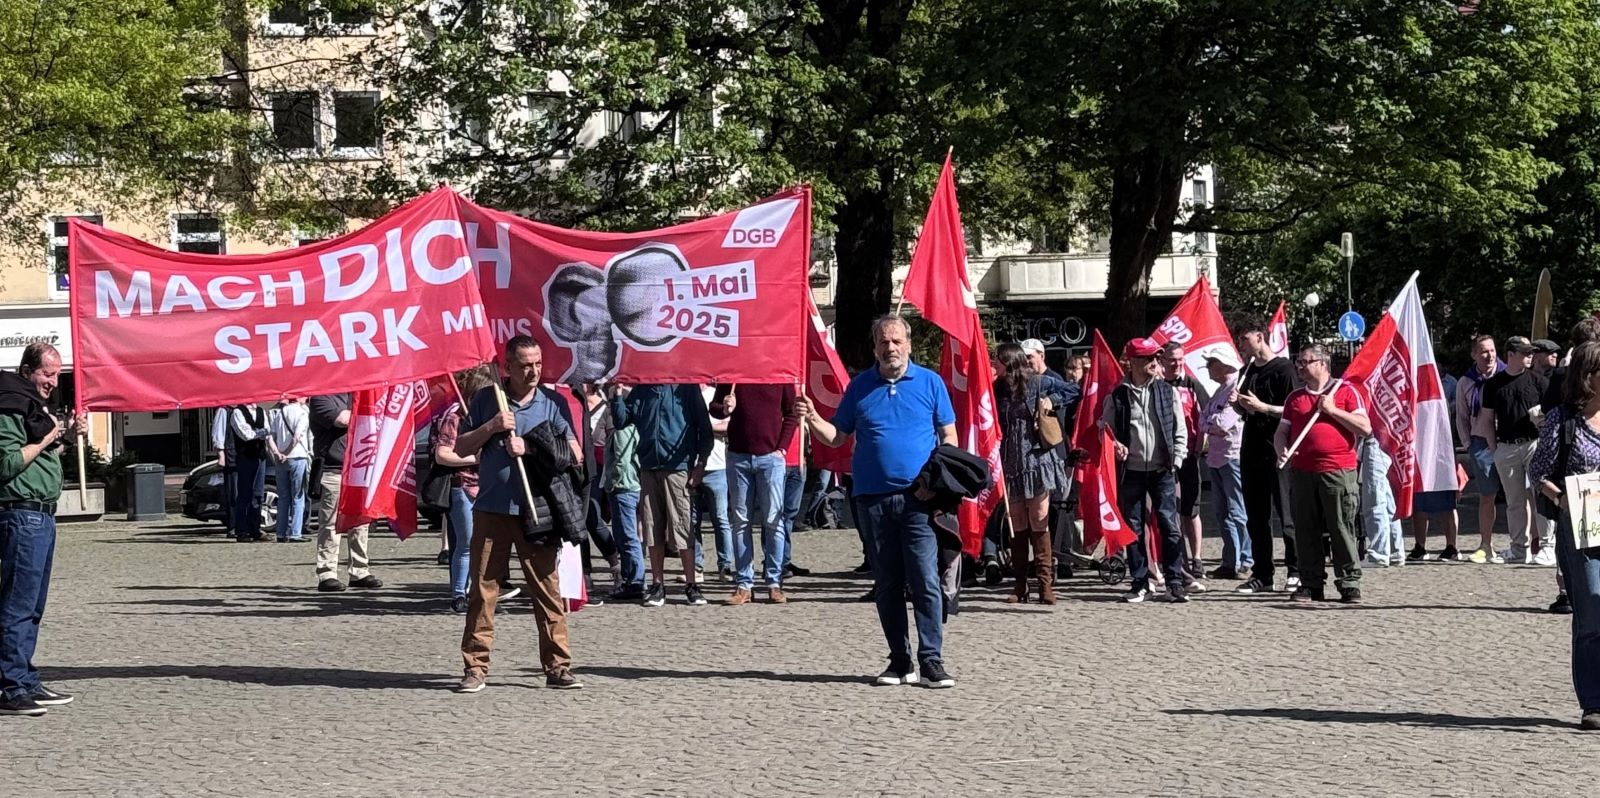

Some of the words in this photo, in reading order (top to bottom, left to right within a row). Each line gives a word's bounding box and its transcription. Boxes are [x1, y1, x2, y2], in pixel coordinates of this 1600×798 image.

[733, 229, 774, 245] DGB
[94, 270, 305, 319] MACH
[318, 219, 512, 303] DICH
[664, 279, 684, 301] 1.
[691, 269, 747, 299] Mai
[656, 305, 731, 337] 2025
[1160, 315, 1193, 344] SPD
[214, 305, 428, 374] STARK
[442, 303, 485, 335] MI
